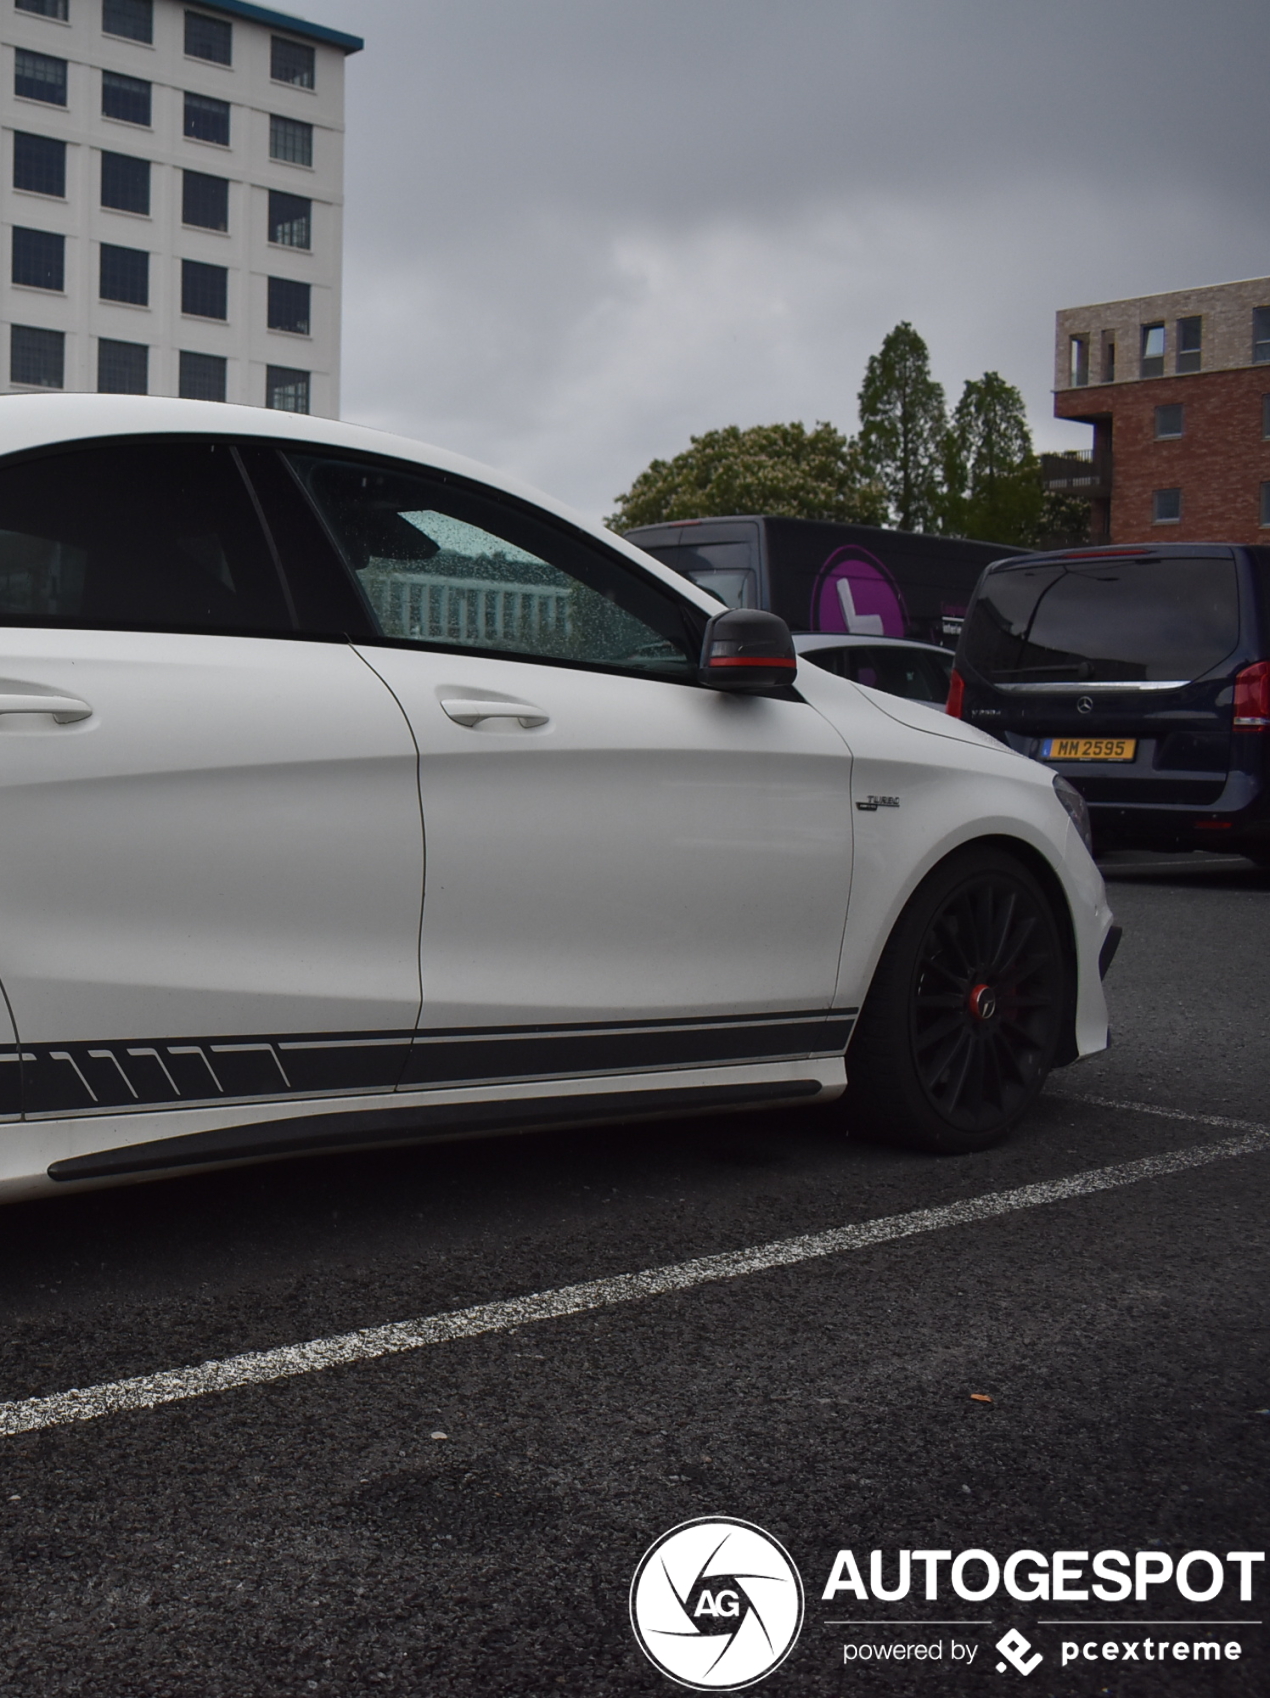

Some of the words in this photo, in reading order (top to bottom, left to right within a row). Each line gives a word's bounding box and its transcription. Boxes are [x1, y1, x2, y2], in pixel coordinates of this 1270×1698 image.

[1057, 740, 1080, 756] MM
[1081, 740, 1126, 756] 2595
[867, 795, 900, 806] TURBO
